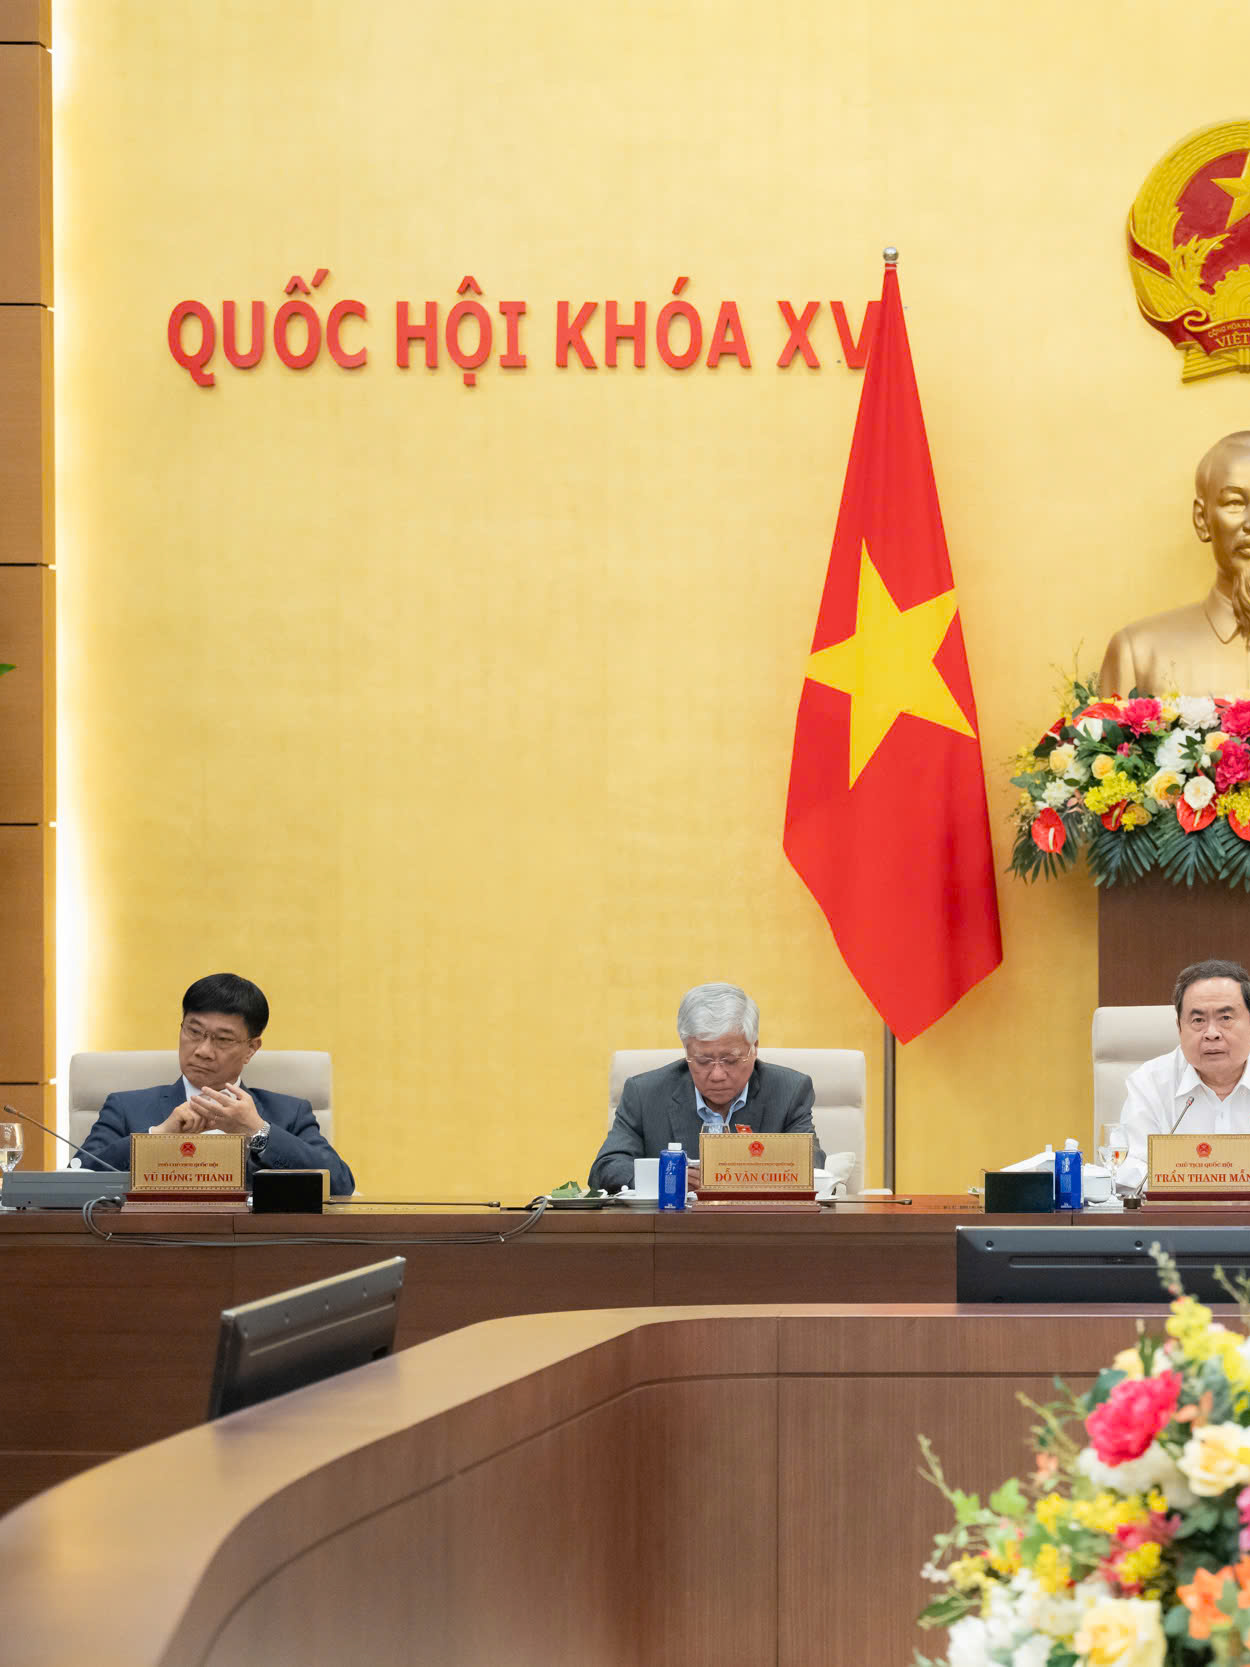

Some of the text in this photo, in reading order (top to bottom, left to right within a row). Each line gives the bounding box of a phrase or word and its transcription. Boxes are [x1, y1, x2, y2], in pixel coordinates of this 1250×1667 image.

[168, 269, 882, 387] QUỐC HỘI KHÓA XV
[195, 1173, 233, 1182] THANH
[761, 1169, 799, 1182] CHIẾN
[1188, 1173, 1226, 1182] THANH
